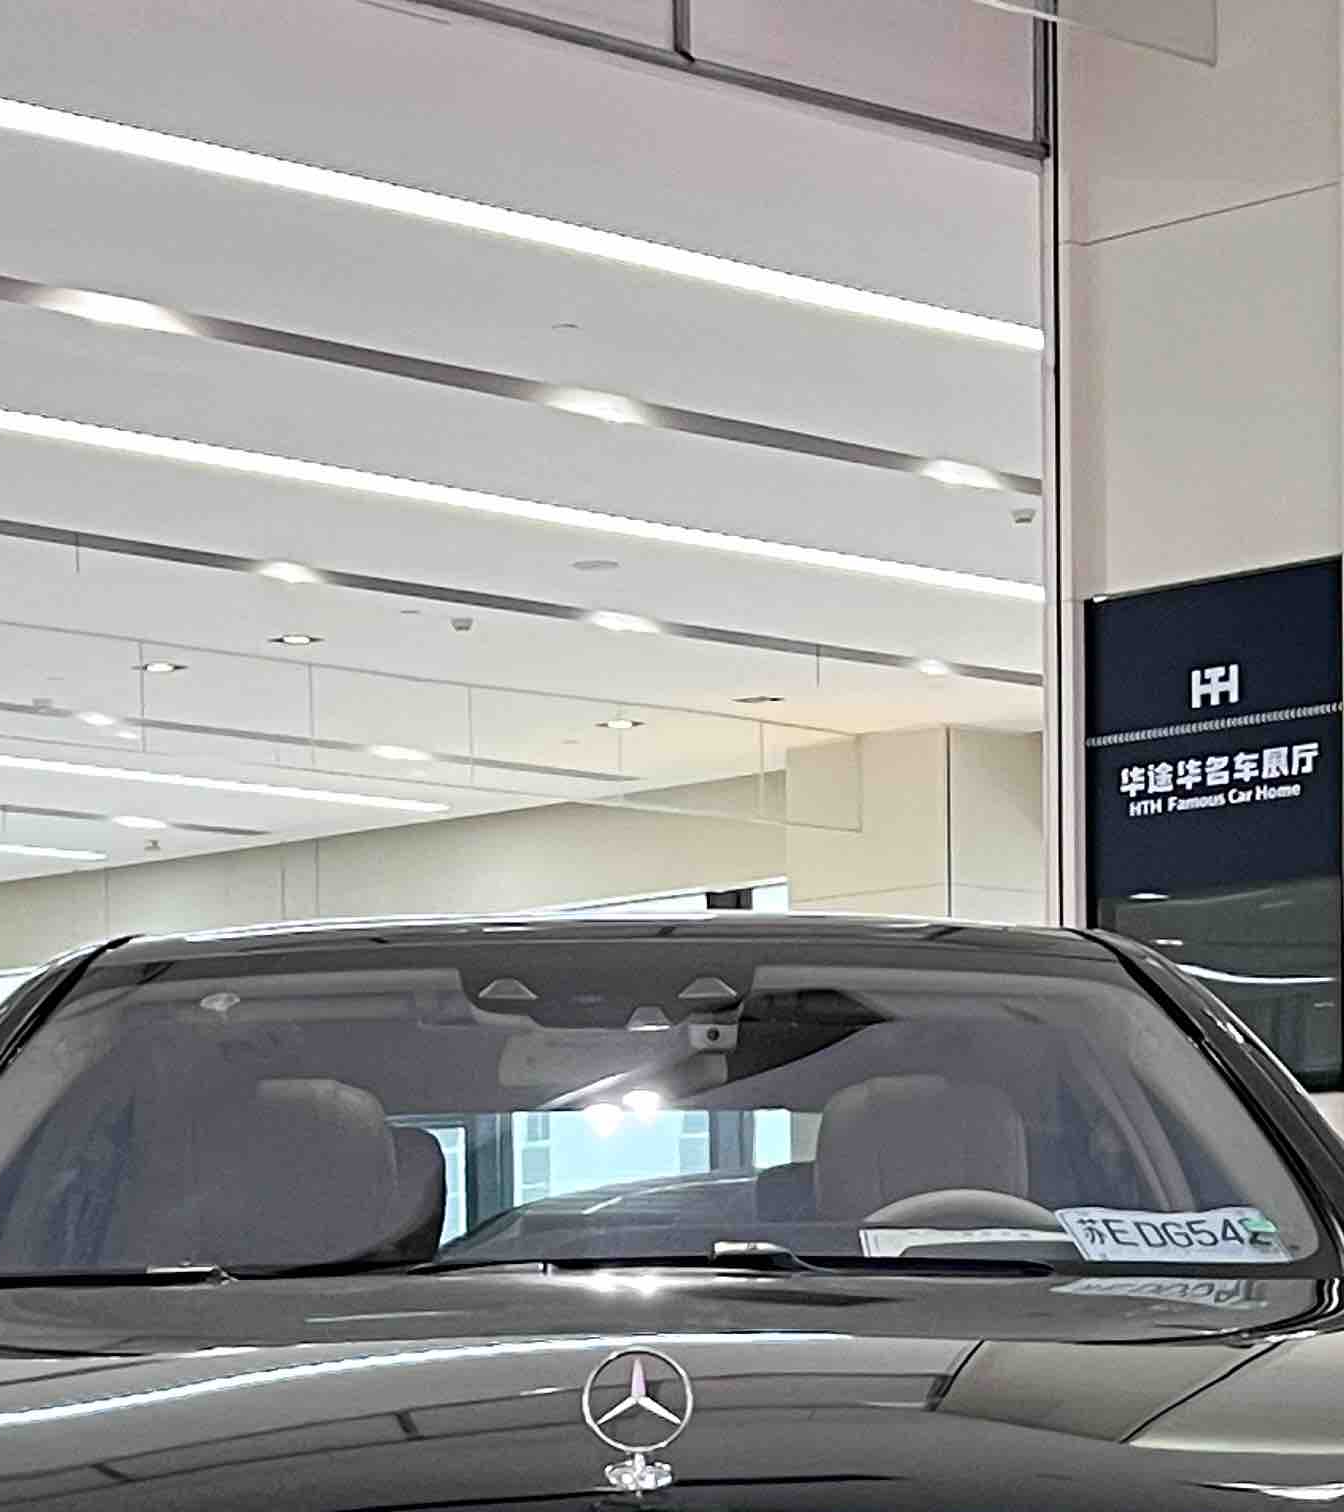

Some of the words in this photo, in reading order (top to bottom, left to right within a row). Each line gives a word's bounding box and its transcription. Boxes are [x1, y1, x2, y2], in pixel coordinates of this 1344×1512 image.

[1120, 741, 1320, 798] 华途华名车展厅
[1128, 798, 1163, 817] HTH
[1167, 792, 1226, 812] Famous
[1227, 787, 1253, 804] Car
[1254, 783, 1301, 800] Home
